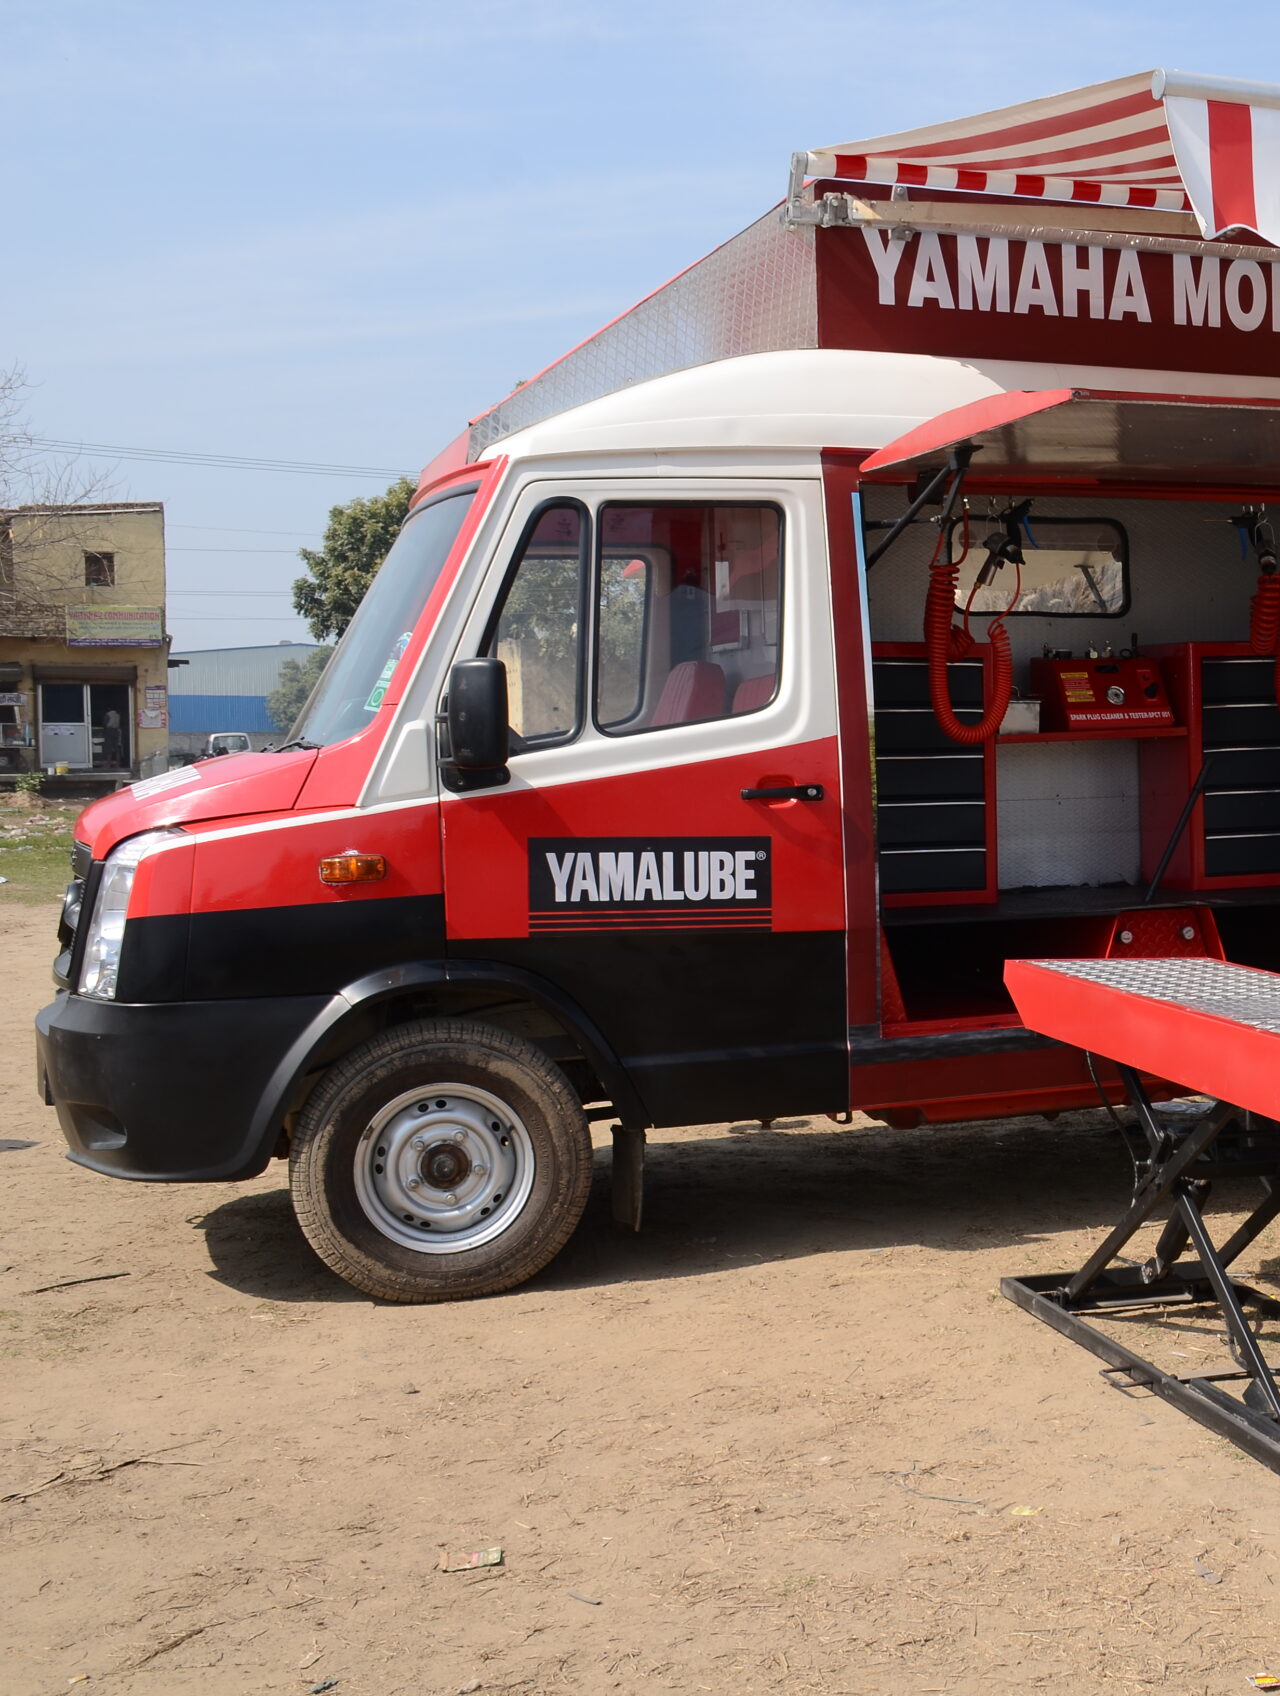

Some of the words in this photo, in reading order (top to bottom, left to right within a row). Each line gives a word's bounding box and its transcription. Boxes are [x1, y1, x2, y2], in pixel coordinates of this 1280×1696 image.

[861, 226, 1152, 323] YAMAHA
[1070, 713, 1087, 721] SPARK
[1101, 712, 1124, 720] CLEANER
